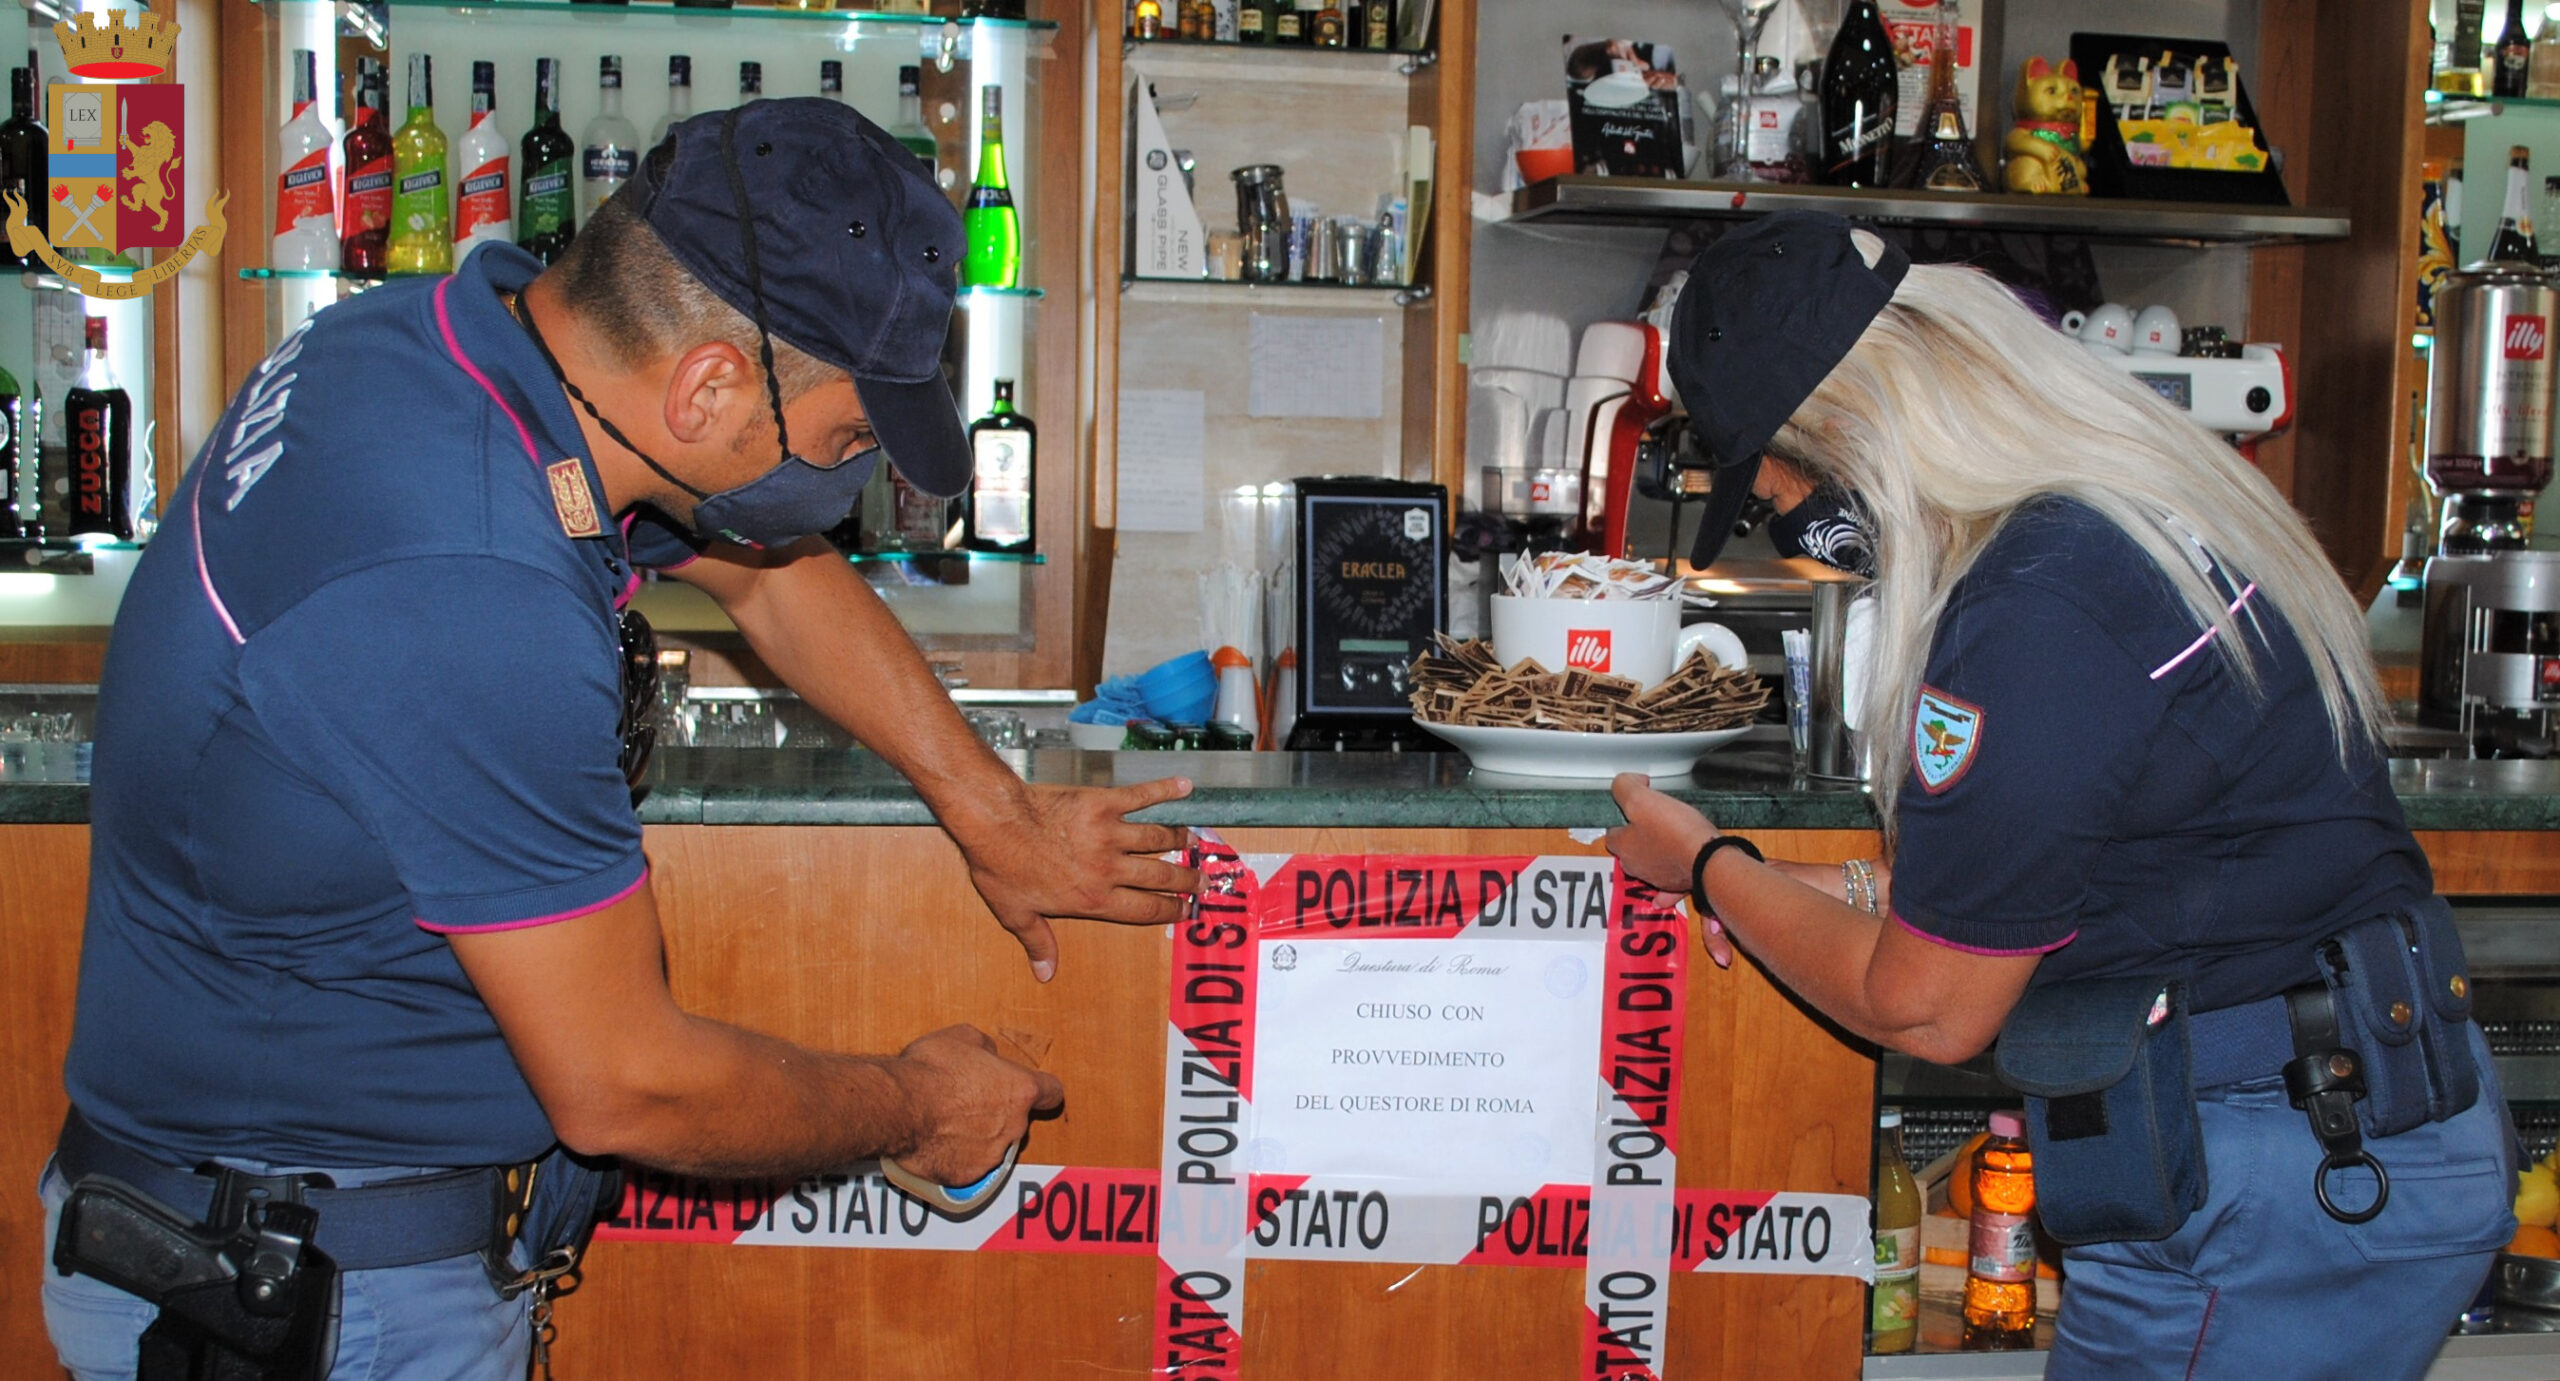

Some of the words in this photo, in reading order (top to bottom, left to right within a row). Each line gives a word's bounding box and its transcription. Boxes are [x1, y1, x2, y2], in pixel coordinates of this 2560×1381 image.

[287, 169, 323, 186] KEGLEVICH
[352, 173, 391, 190] KEGLEVICH
[1157, 236, 1168, 271] PIPE
[1178, 230, 1189, 271] NEW
[2506, 322, 2544, 356] illy
[1532, 485, 1549, 498] illy
[1342, 562, 1406, 579] ERACLEA
[1569, 635, 1609, 670] illy
[1296, 868, 1465, 929] POLIZIA
[1479, 870, 1518, 928] DI
[1531, 869, 1613, 930] STA
[1336, 951, 1413, 974] Questura
[1415, 954, 1441, 973] di
[1447, 954, 1511, 976] Roma
[1184, 963, 1245, 1005] DI
[1618, 971, 1673, 1012] DI
[1356, 1002, 1432, 1020] CHIUSO
[1442, 1004, 1485, 1021] CON
[1331, 1048, 1505, 1068] PROVVEDIMENTO
[1177, 1018, 1243, 1186] POLIZIA
[1295, 1094, 1334, 1111] DEL
[1340, 1095, 1444, 1114] QUESTORE
[1450, 1097, 1470, 1112] DI
[1476, 1097, 1535, 1114] ROMA
[1607, 1024, 1671, 1186] POLIZIA
[733, 1178, 775, 1232] DI
[791, 1174, 931, 1237] STATO
[1253, 1187, 1389, 1250] STATO
[1704, 1202, 1832, 1263] STATO
[1167, 1271, 1232, 1381] TATO
